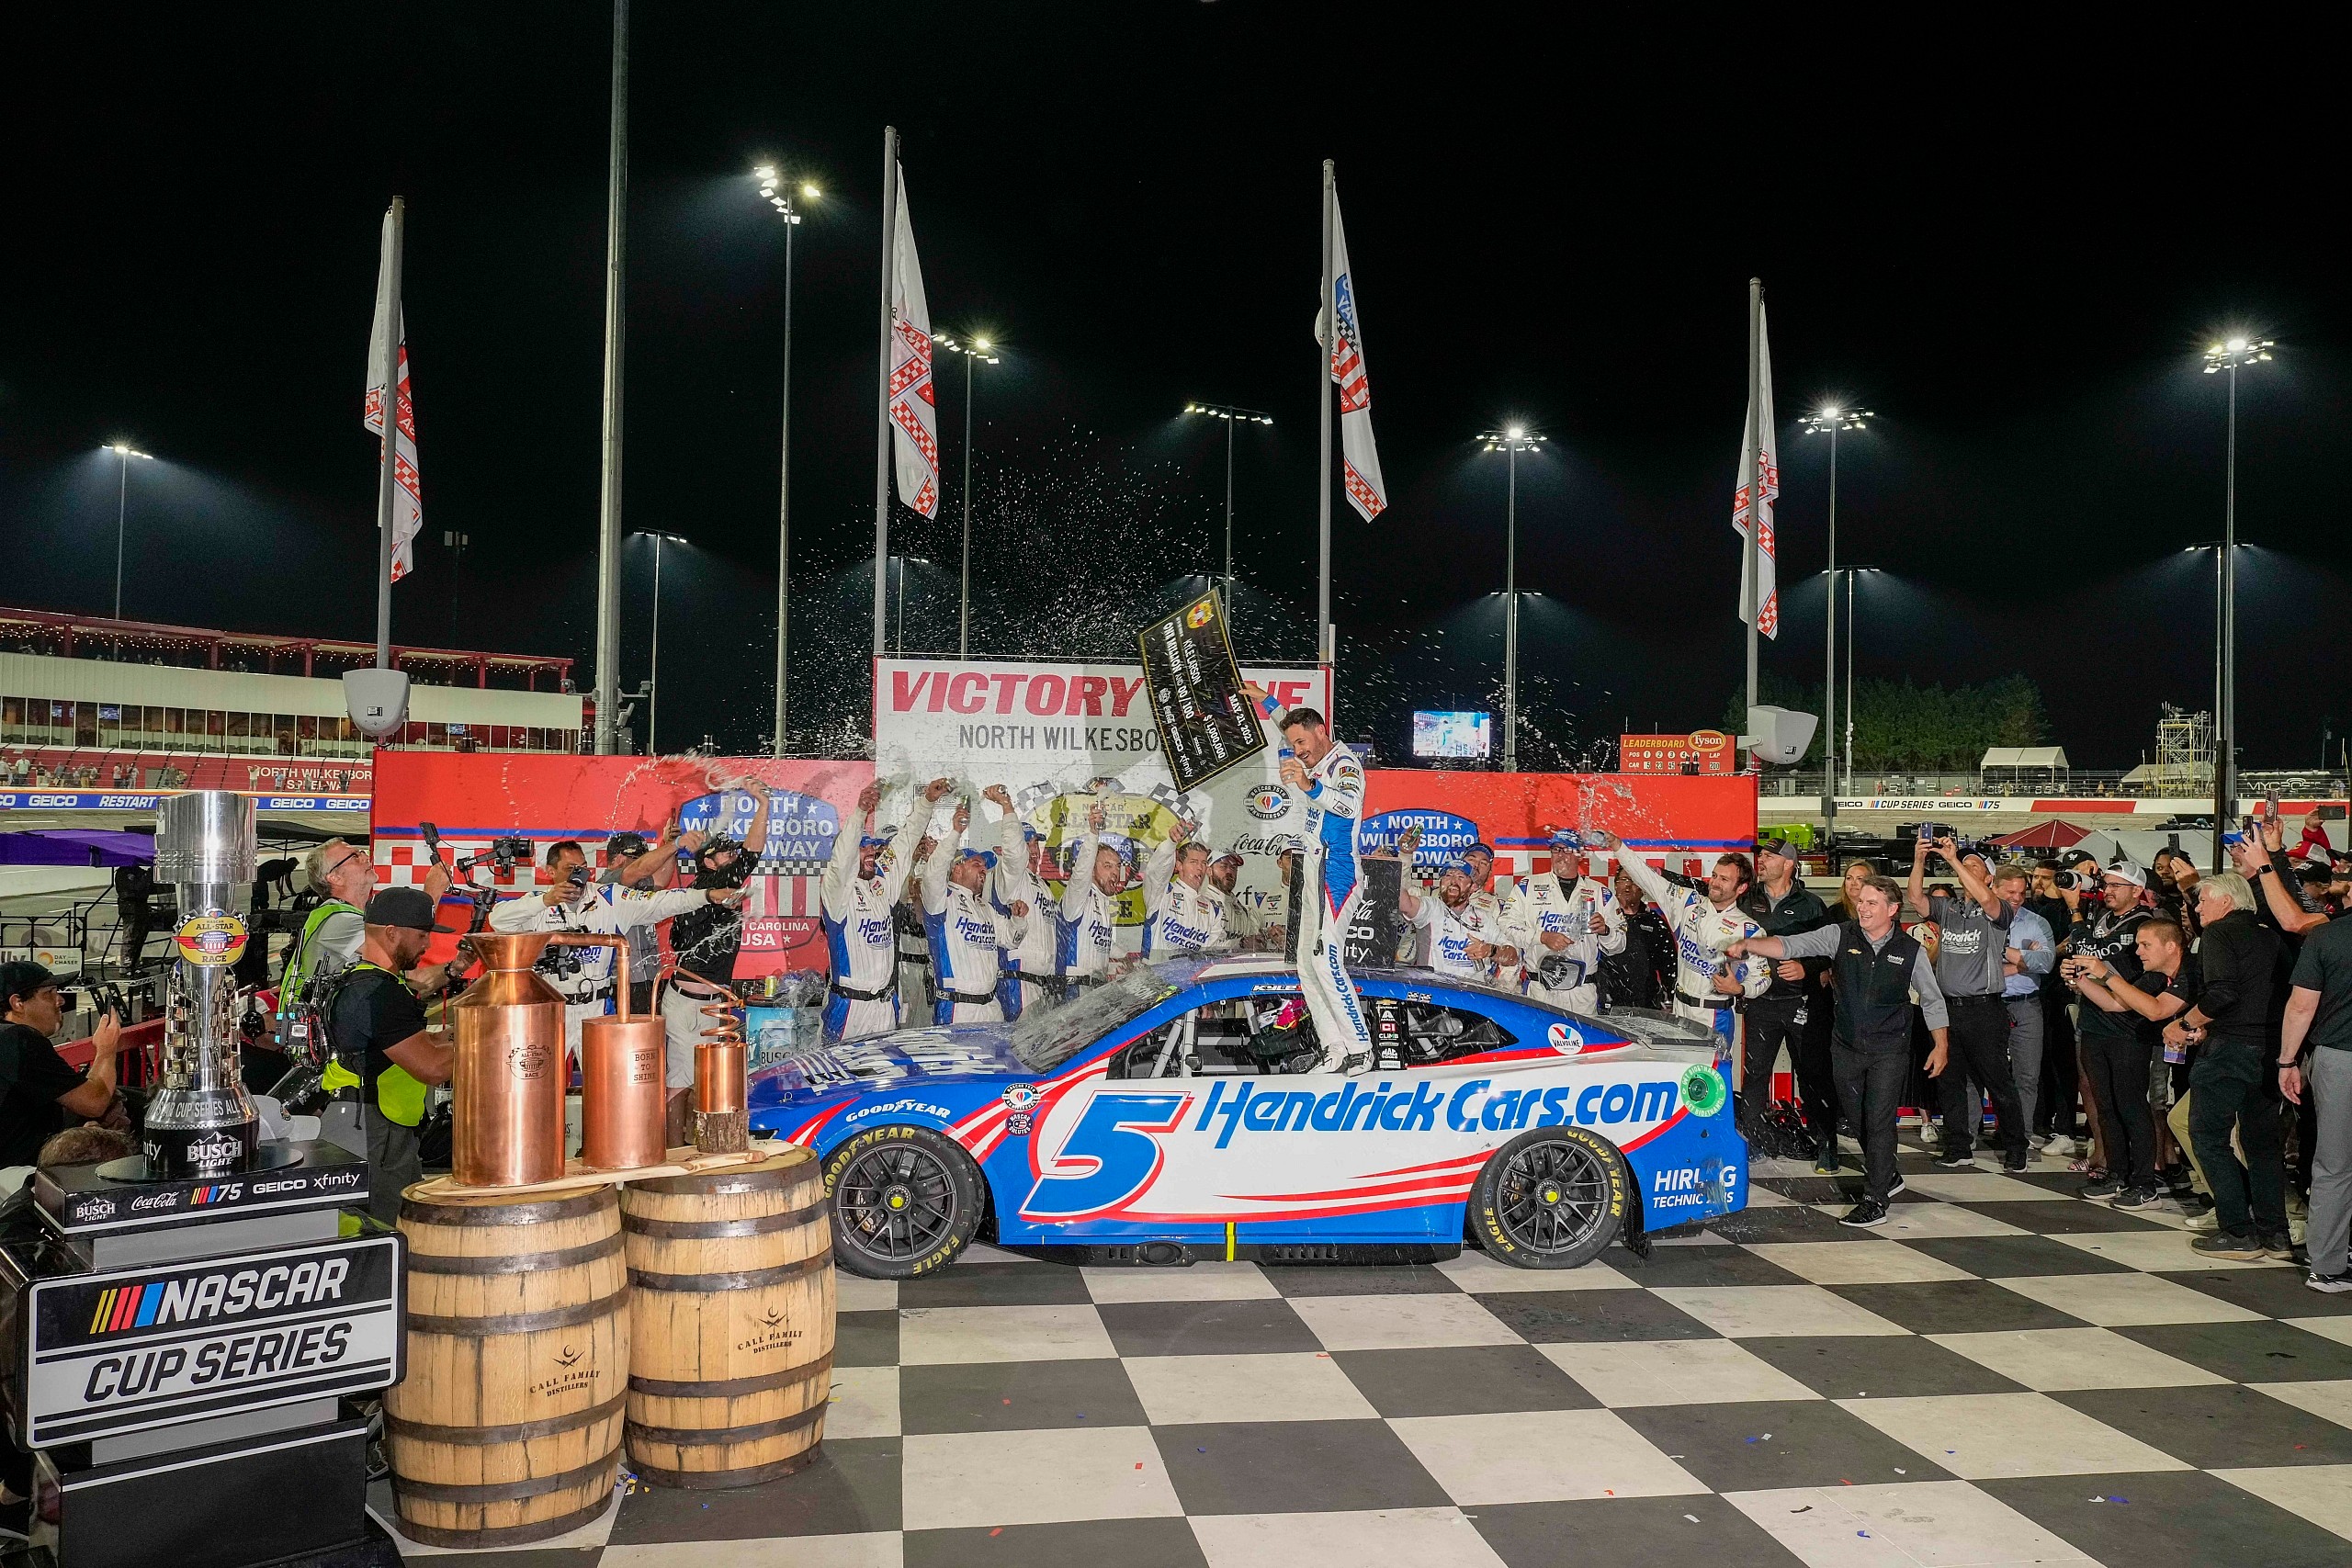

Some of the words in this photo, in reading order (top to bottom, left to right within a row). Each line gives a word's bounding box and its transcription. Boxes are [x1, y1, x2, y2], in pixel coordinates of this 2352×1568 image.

[1167, 637, 1182, 674] MILLION
[1187, 656, 1202, 685] LARSON
[892, 671, 1145, 717] VICTORY
[1228, 694, 1242, 713] MAY
[1240, 725, 1253, 745] 2023
[959, 725, 1035, 750] NORTH
[1039, 726, 1162, 751] WILKESBO
[1170, 726, 1183, 752] GEICO
[1623, 739, 1685, 748] LEADERBOARD
[1693, 735, 1723, 746] Tyson
[28, 795, 78, 807] GEICO
[99, 795, 156, 807] RESTART
[269, 798, 315, 808] GEICO
[326, 799, 370, 809] GEICO
[1881, 800, 1899, 808] CUP
[1901, 800, 1934, 809] SERIES
[1987, 800, 2001, 809] 75
[749, 922, 809, 931] CAROLINA
[1163, 917, 1210, 943] Hendrick
[1165, 932, 1202, 952] Cars.com
[1552, 1039, 1580, 1048] VALVOLINE
[635, 1053, 656, 1062] BORN
[633, 1071, 656, 1081] SHINE
[175, 1102, 193, 1118] CUP
[194, 1100, 224, 1118] SERIES
[846, 1099, 951, 1122] GOODYEAR
[1010, 1113, 1030, 1122] NASCAR
[187, 1141, 242, 1162] BUSCH
[1019, 1089, 1193, 1220] 5
[76, 1203, 116, 1219] BUSCH
[131, 1191, 179, 1211] Coca-Cola
[216, 1183, 243, 1202] 75
[253, 1179, 307, 1195] GEICO
[313, 1173, 360, 1189] xfinity
[1484, 1206, 1516, 1253] EAGLE
[913, 1234, 960, 1275] EAGLE
[156, 1258, 349, 1325] NASCAR
[738, 1337, 764, 1350] CALL
[769, 1330, 803, 1341] FAMILY
[753, 1341, 792, 1354] DISTILLERS
[84, 1348, 187, 1403] CUP
[190, 1322, 352, 1385] SERIES
[529, 1378, 559, 1393] CALL
[564, 1370, 601, 1382] FAMILY
[547, 1382, 588, 1397] DISTILLERS
